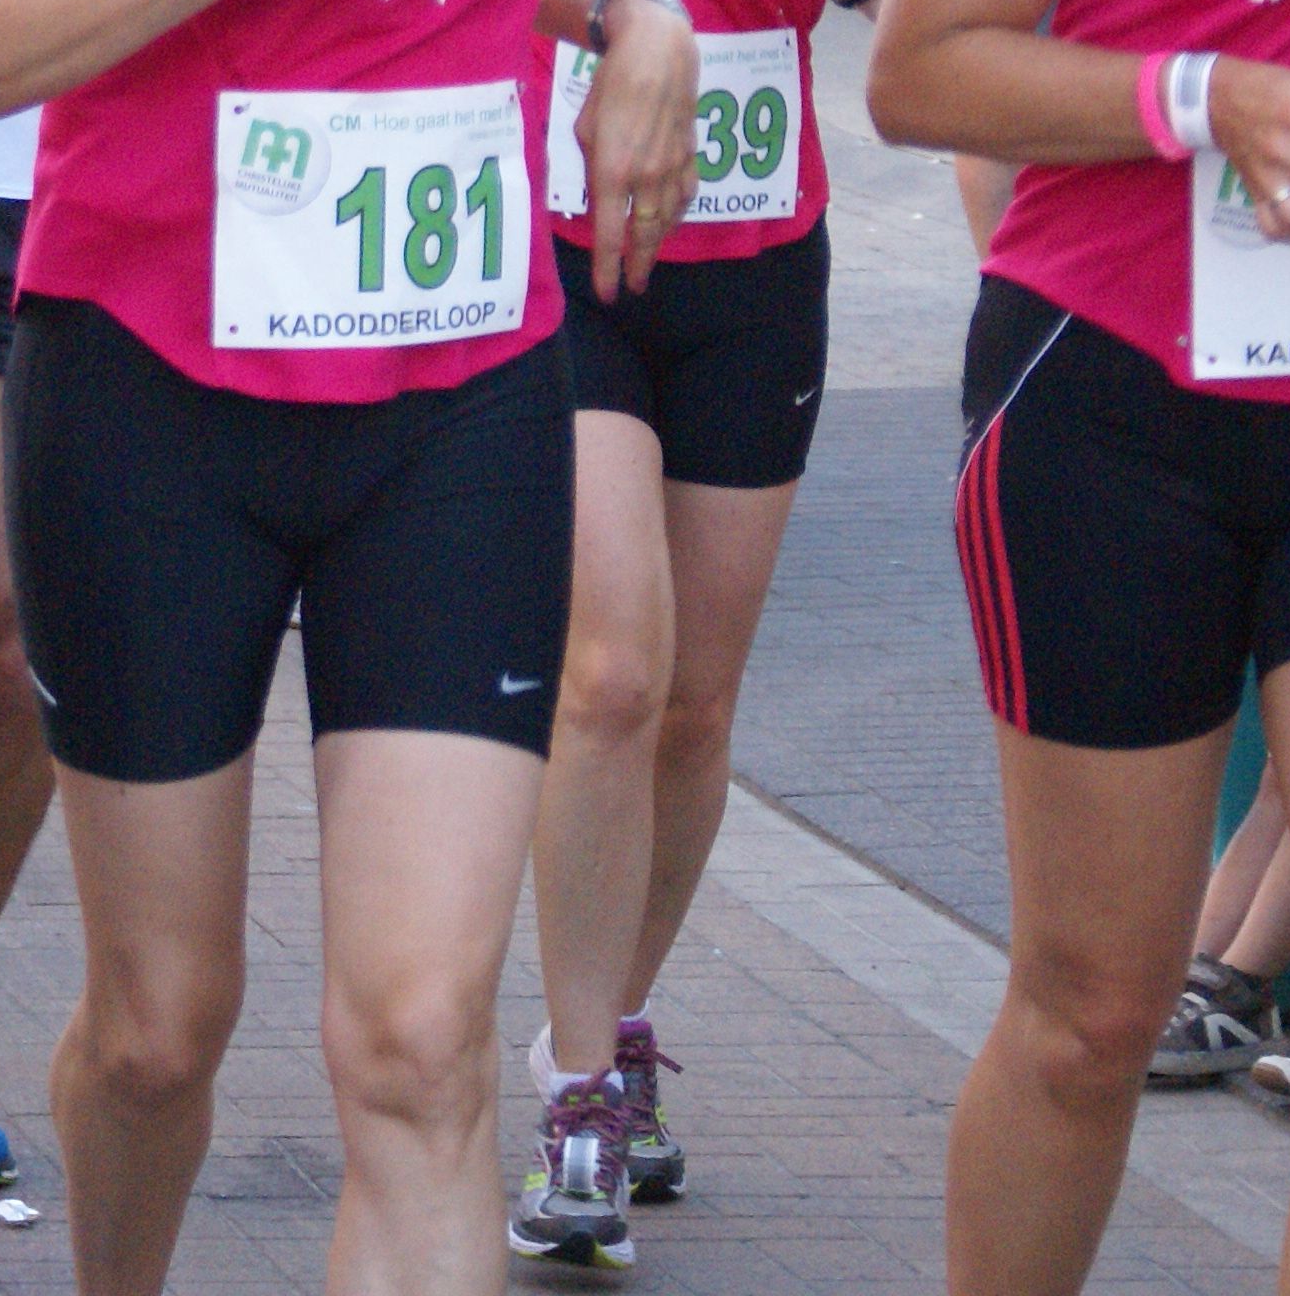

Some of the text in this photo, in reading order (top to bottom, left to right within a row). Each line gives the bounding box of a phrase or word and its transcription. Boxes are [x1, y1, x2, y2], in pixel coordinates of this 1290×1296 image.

[328, 113, 361, 132] CM
[695, 87, 788, 182] 39
[336, 155, 503, 294] 181
[268, 301, 497, 338] KADODDERLOOP
